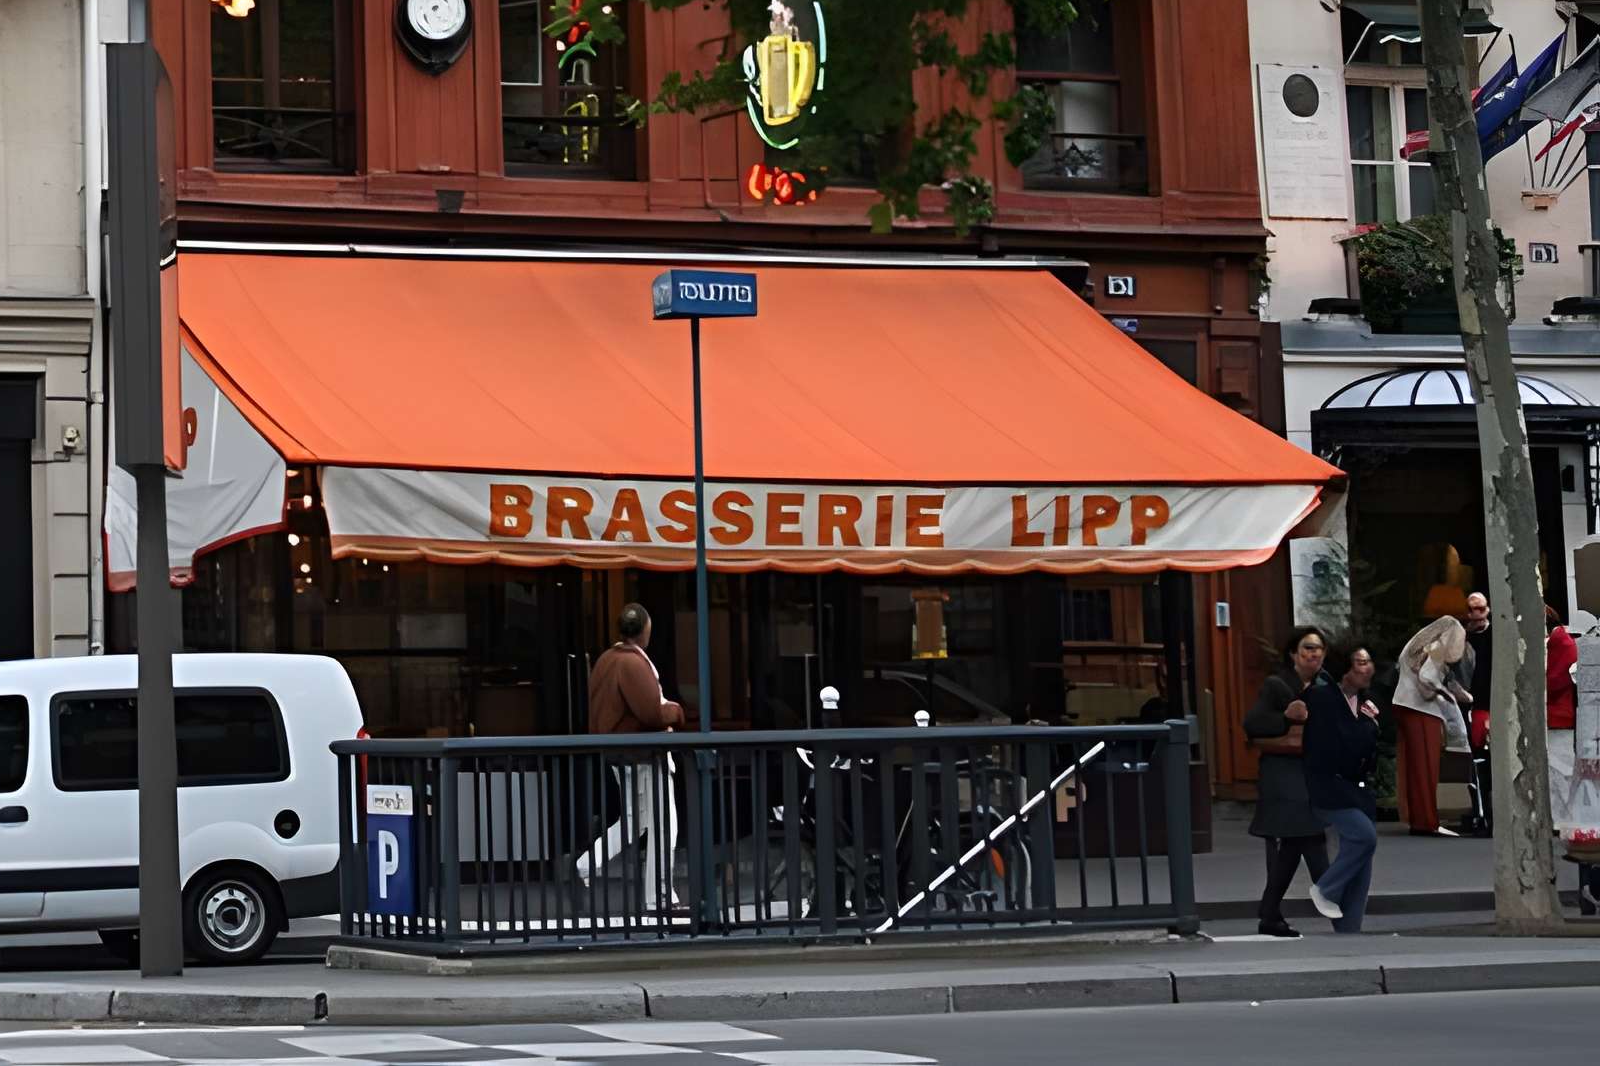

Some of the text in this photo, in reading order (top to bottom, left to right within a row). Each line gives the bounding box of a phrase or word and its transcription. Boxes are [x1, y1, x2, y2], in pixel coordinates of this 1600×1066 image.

[489, 484, 1170, 548] BRASSERIE LIPP
[378, 829, 400, 900] P
